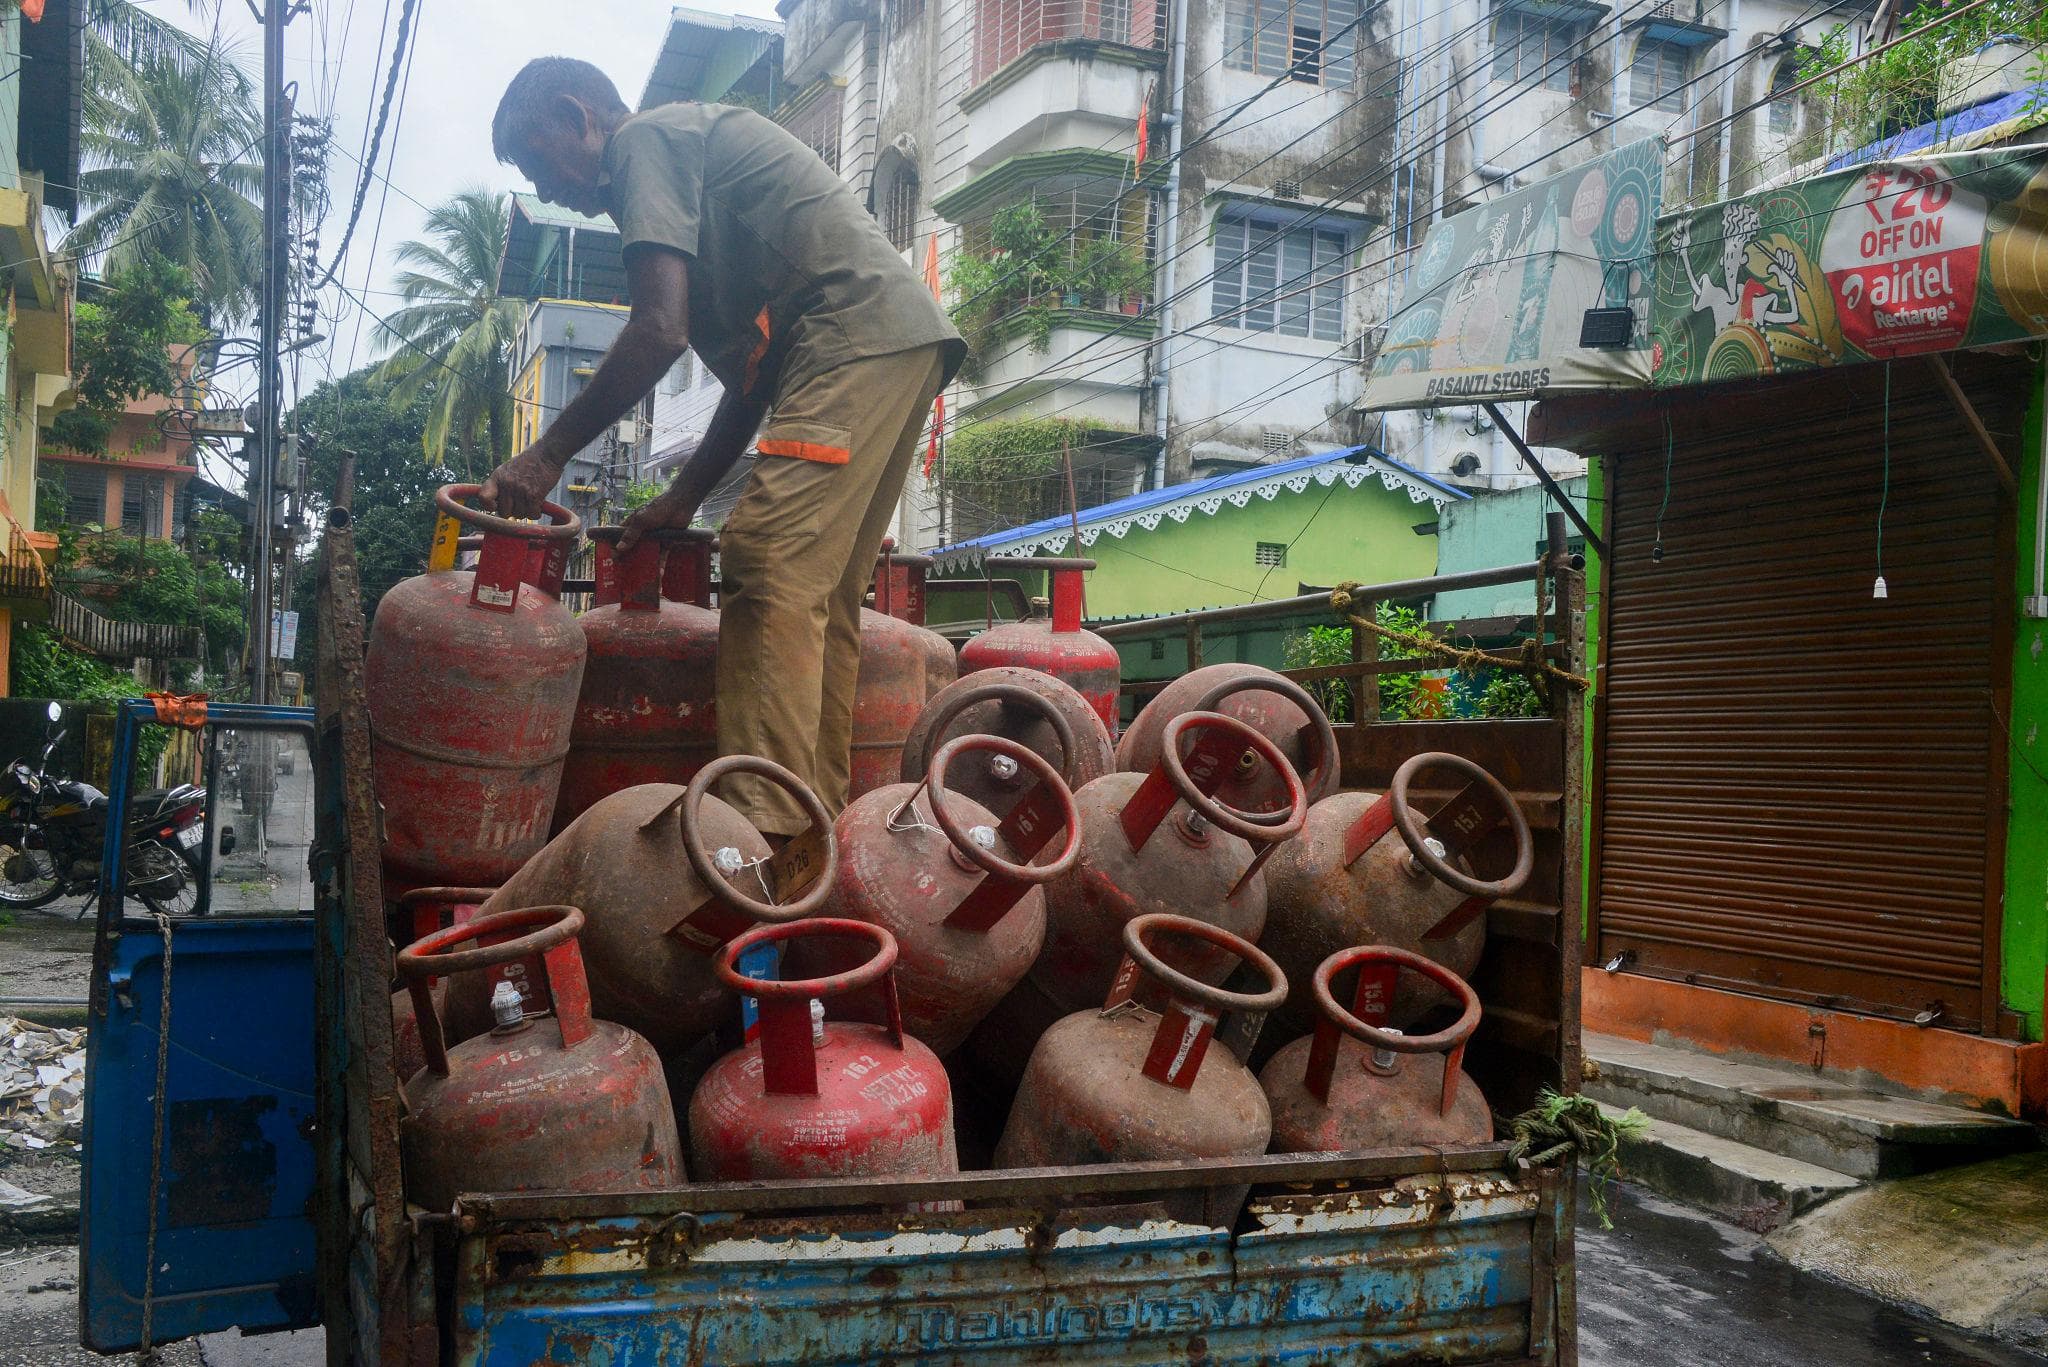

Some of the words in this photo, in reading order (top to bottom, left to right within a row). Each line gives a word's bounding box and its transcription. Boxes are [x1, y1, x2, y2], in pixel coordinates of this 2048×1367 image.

[1860, 223, 1905, 259] OFF
[1909, 216, 1943, 249] ON
[1869, 256, 1953, 307] airtel
[1426, 374, 1489, 398] BASANTI
[1491, 367, 1551, 392] STORES
[842, 1055, 881, 1081] 16.2
